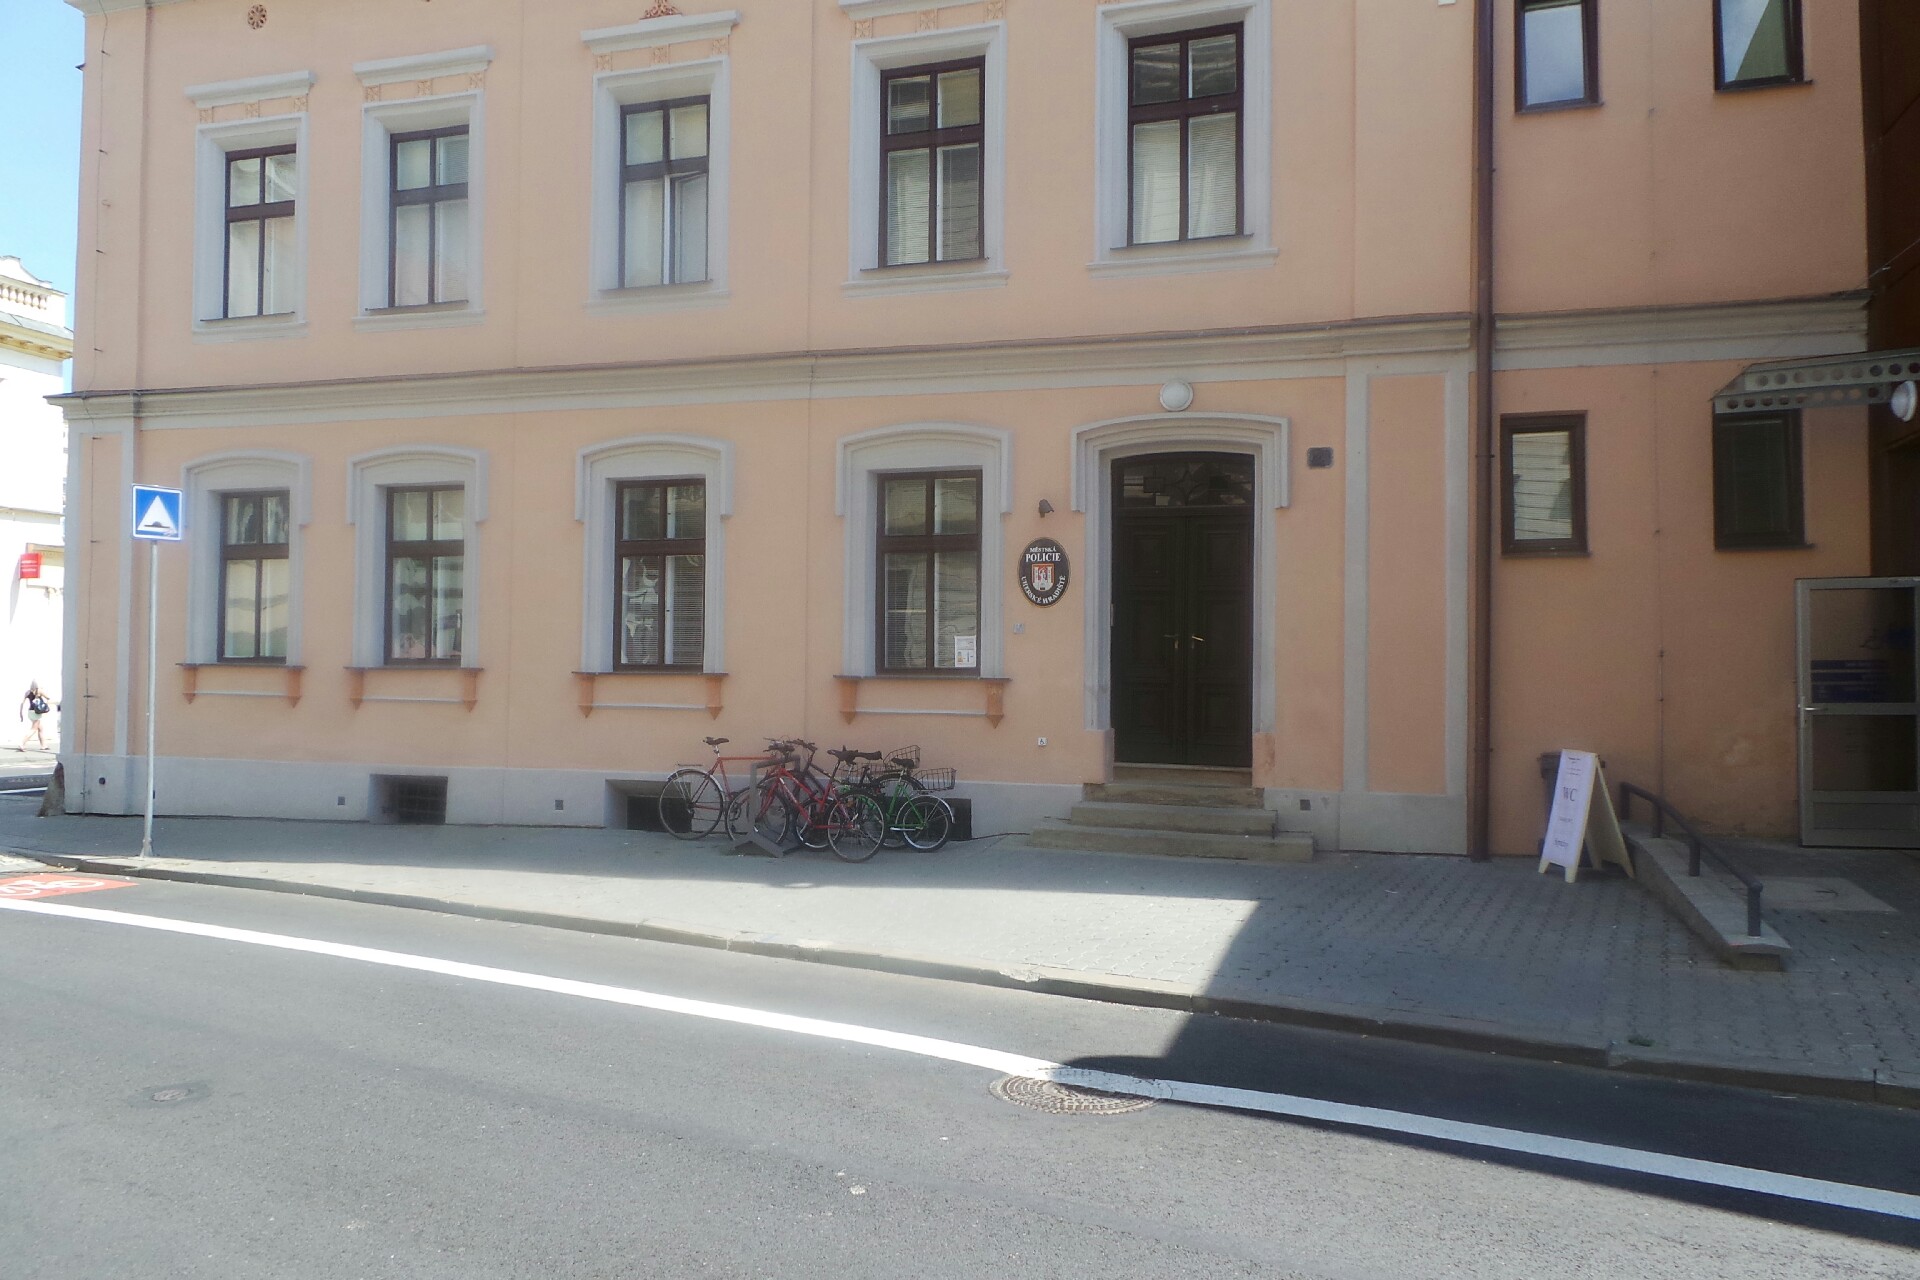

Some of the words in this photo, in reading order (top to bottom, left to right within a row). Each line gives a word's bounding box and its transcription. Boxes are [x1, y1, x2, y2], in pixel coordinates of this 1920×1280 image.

[1025, 553, 1061, 562] POLICIE
[1021, 576, 1041, 603] UHERSKÉ
[1043, 574, 1066, 604] HRADIŠTĚ
[1563, 786, 1578, 801] WC
